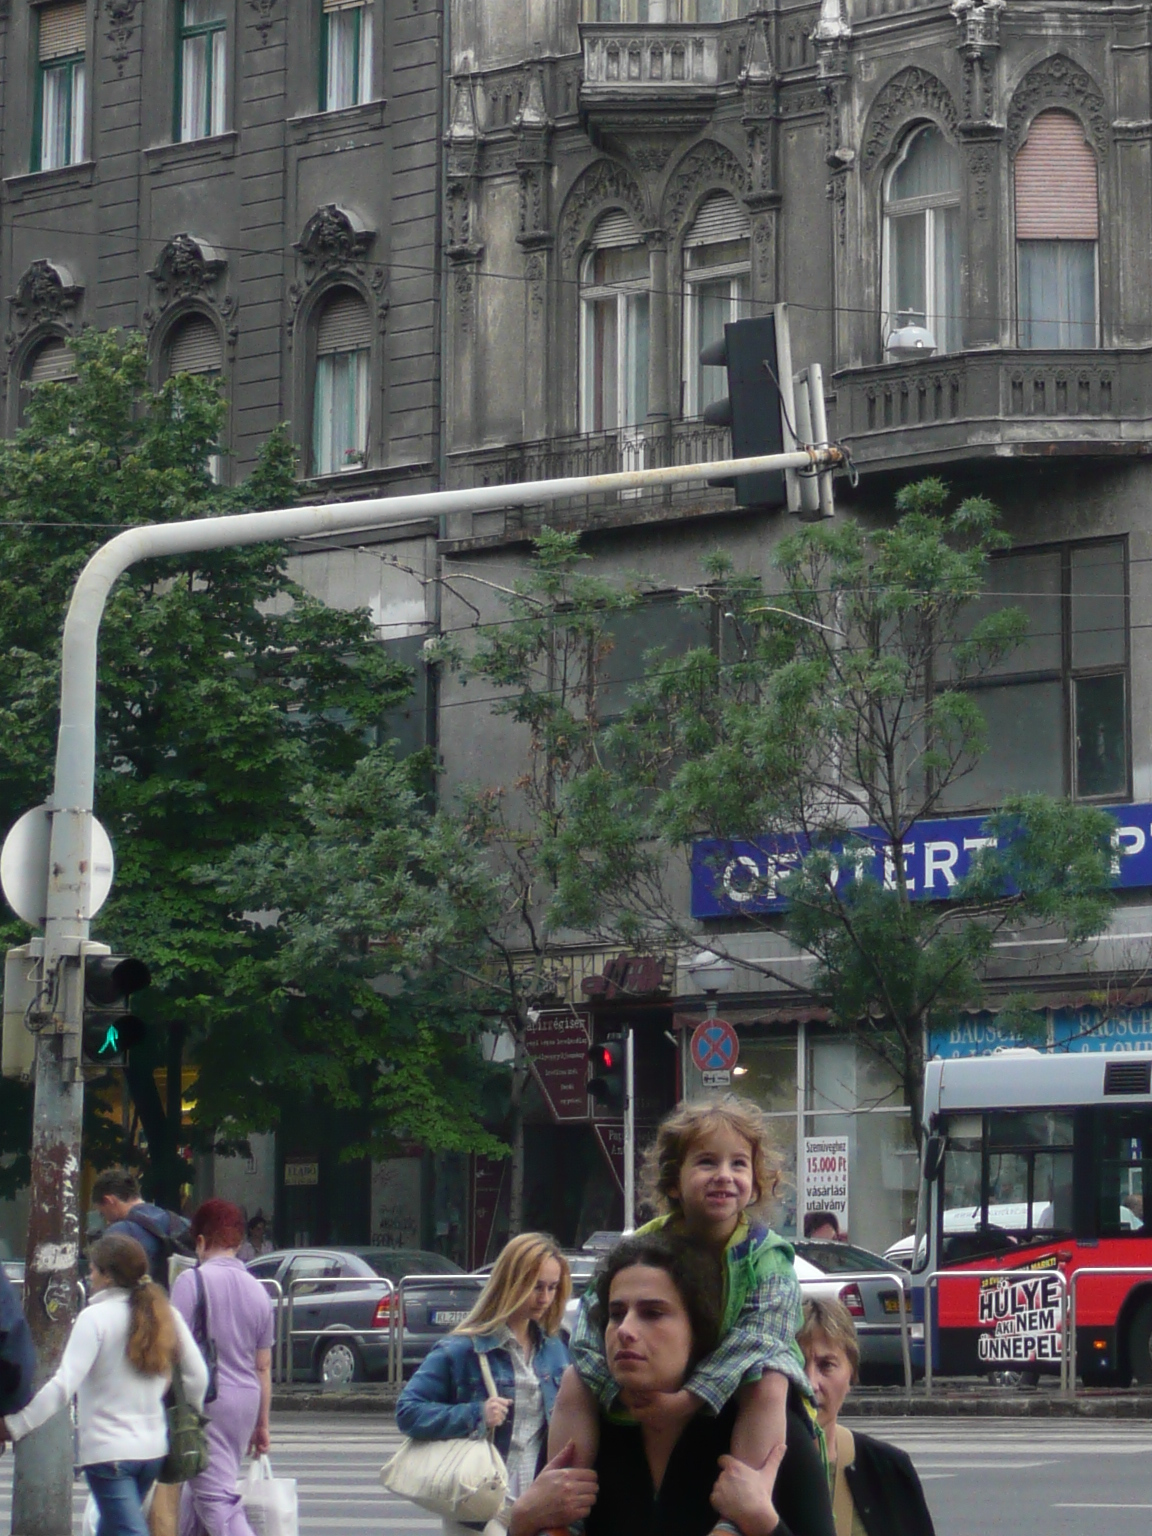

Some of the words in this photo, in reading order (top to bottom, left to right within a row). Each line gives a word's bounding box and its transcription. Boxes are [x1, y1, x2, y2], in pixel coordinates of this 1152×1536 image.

[807, 1157, 836, 1173] 15.000
[838, 1156, 847, 1172] Ft
[996, 1321, 1014, 1335] AKI
[1016, 1310, 1055, 1332] NEM
